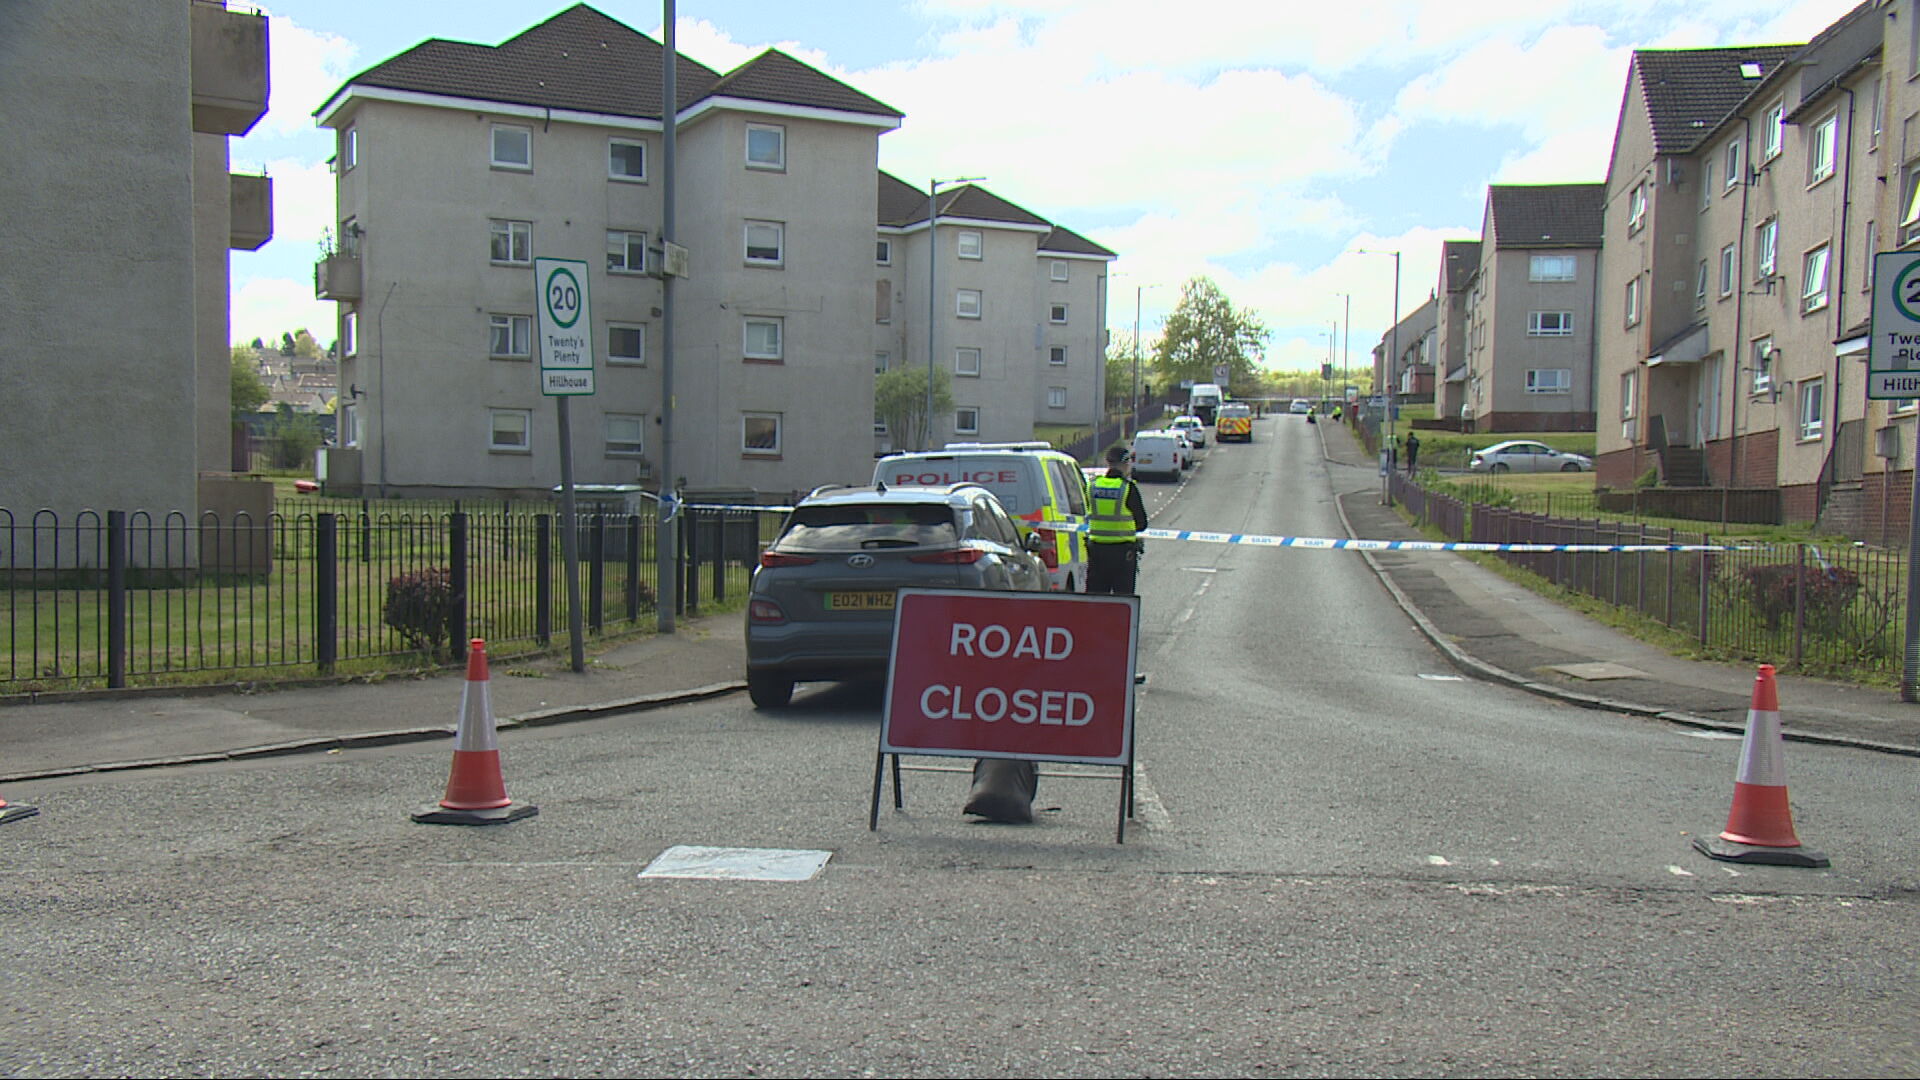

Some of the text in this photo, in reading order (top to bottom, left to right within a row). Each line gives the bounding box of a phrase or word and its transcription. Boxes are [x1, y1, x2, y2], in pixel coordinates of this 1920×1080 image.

[552, 286, 577, 311] 20
[548, 335, 585, 350] Twenty's
[554, 350, 580, 364] Plenty
[549, 375, 587, 388] Hillhouse
[895, 470, 1018, 486] POLICE
[950, 623, 1074, 661] ROAD
[920, 684, 1095, 727] CLOSED
